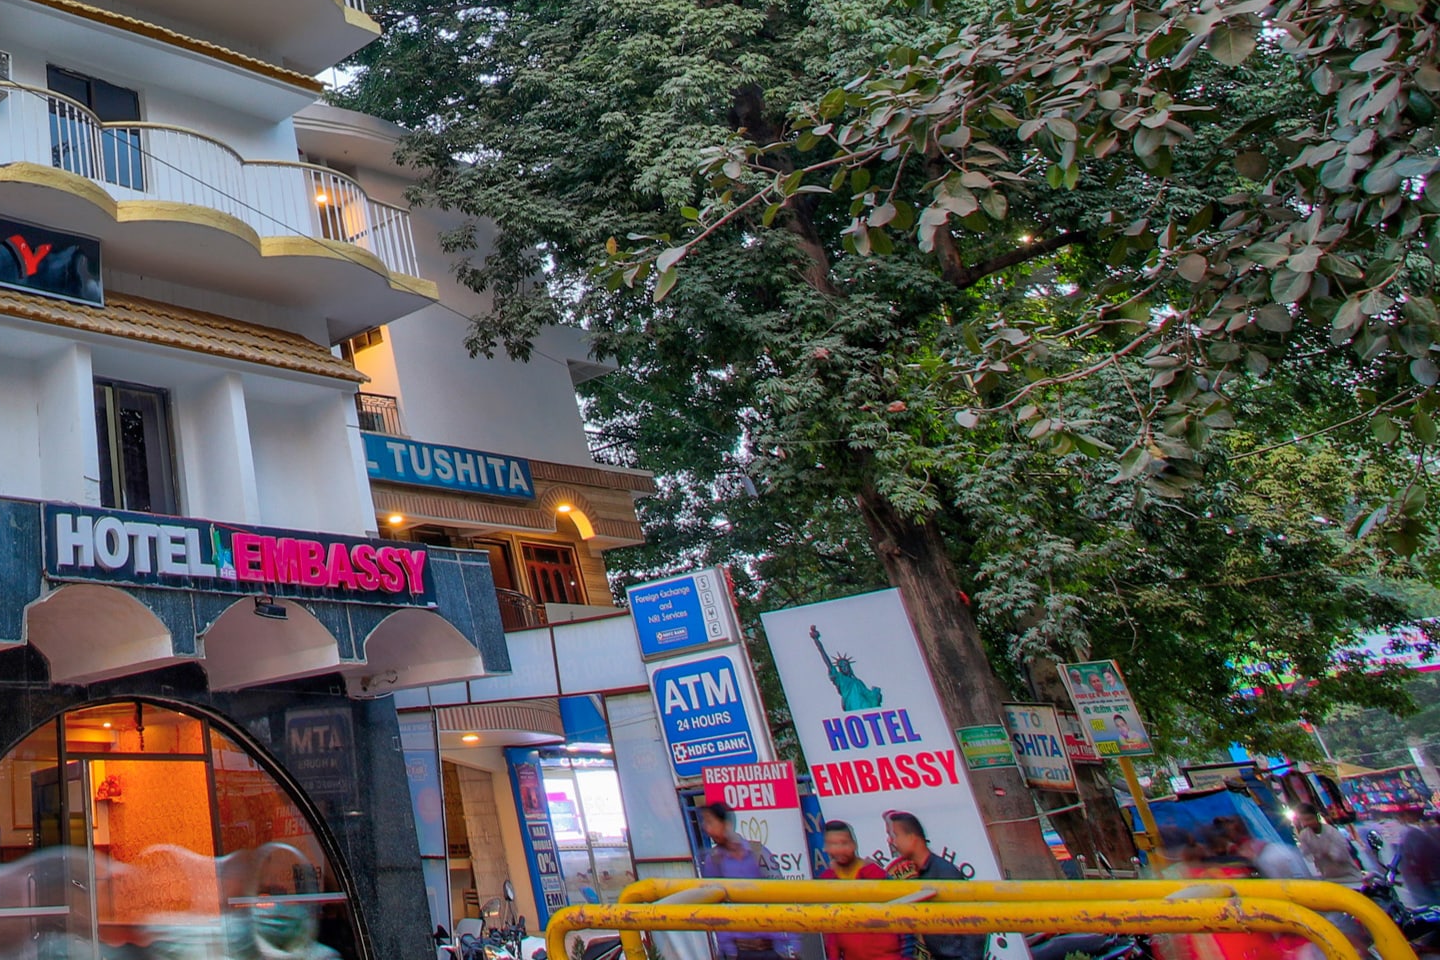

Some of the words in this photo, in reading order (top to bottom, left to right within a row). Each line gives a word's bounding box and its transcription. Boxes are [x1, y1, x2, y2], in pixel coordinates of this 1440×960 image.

[386, 442, 531, 494] TUSHITA
[56, 513, 217, 577] HOTEL
[232, 532, 426, 595] EMBASSY
[635, 593, 660, 604] Foreign
[660, 586, 691, 599] Exchange
[659, 600, 673, 611] and
[662, 610, 688, 622] Services
[665, 668, 738, 715] ATM
[677, 719, 690, 731] 24
[691, 711, 732, 729] HOURS
[822, 708, 922, 751] HOTEL
[688, 743, 715, 757] HDFC
[717, 737, 747, 752] BANK
[705, 763, 788, 784] RESTAURANT
[811, 749, 959, 797] EMBASSY
[724, 783, 776, 808] OPEN
[537, 853, 556, 873] 0%
[758, 852, 802, 871] ASSY
